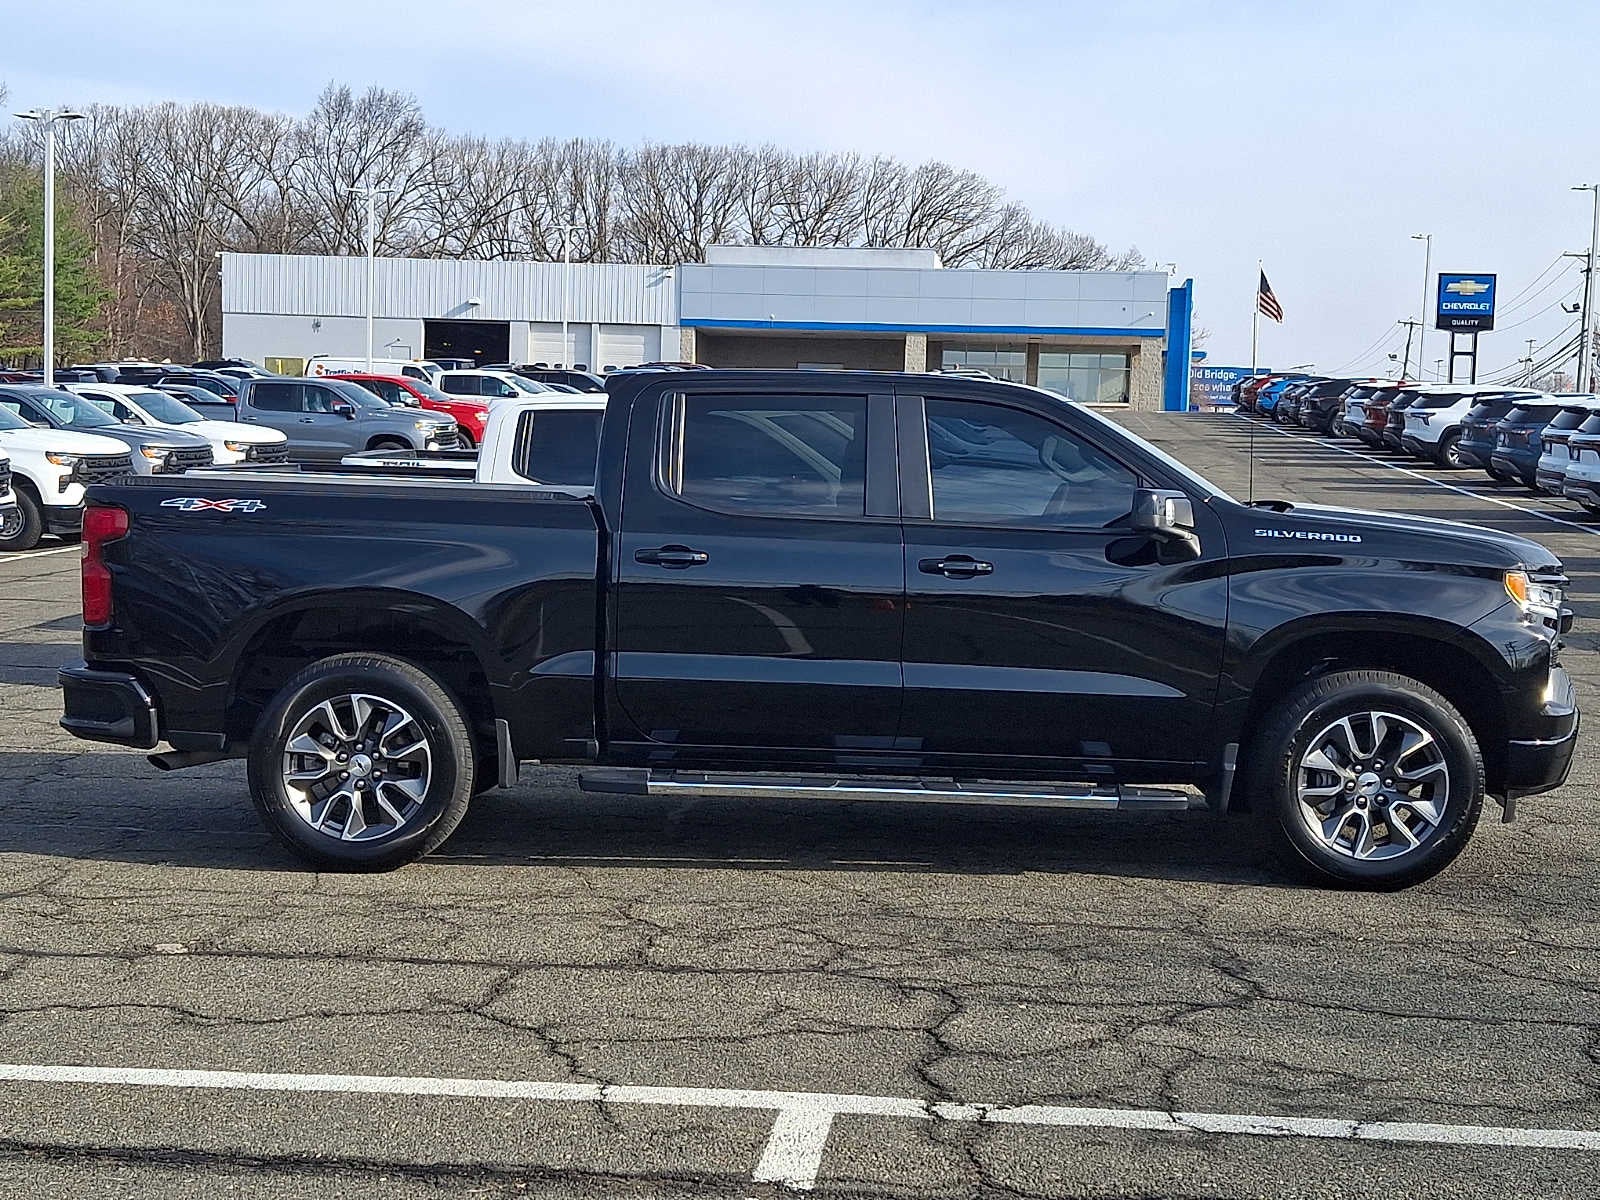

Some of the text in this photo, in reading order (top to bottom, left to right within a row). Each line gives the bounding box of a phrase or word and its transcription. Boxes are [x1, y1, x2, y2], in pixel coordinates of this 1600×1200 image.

[1442, 302, 1490, 310] CHEVROLET
[1204, 369, 1237, 381] Bridge:
[1254, 529, 1362, 543] SILVERADO
